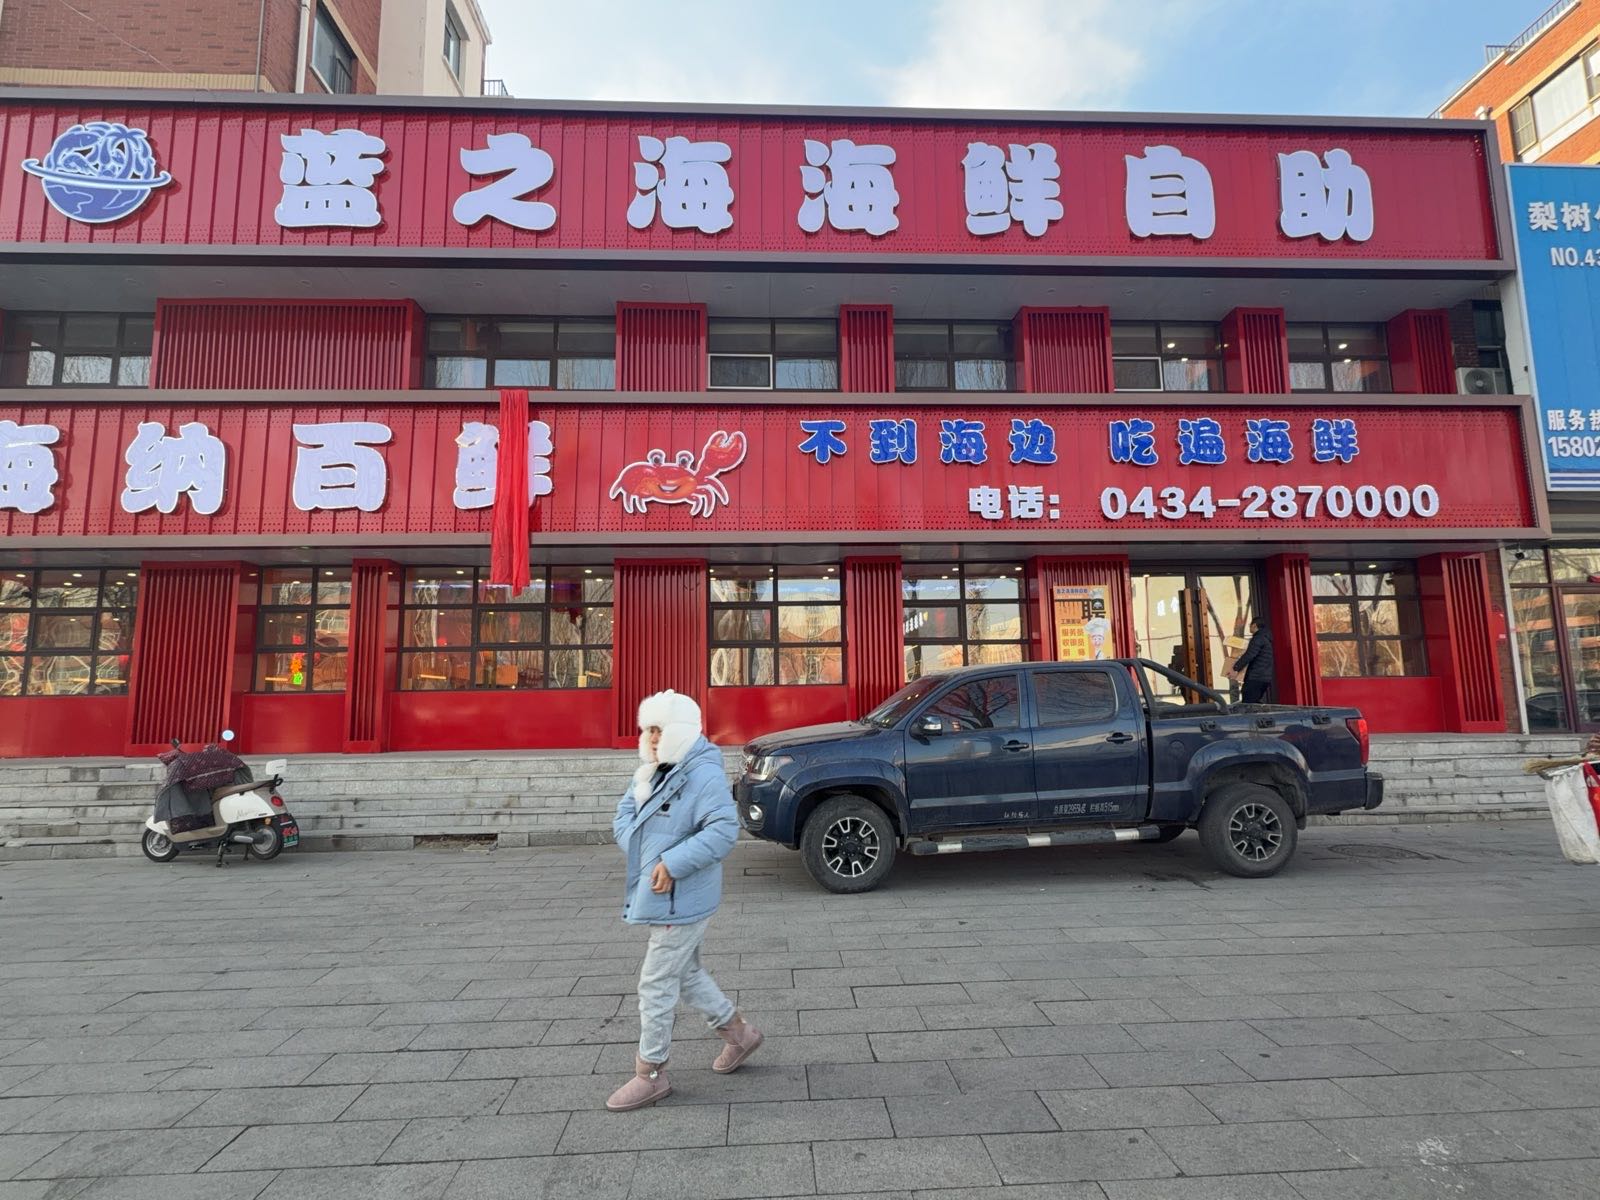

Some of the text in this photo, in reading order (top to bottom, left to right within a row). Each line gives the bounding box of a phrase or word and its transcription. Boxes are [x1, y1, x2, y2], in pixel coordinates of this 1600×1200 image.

[274, 128, 1374, 241] 蓝之海海鲜自助
[1527, 201, 1600, 232] 梨树
[798, 417, 1359, 466] 不到海边 吃遍海鲜
[1101, 484, 1439, 520] 0434-2870000
[1062, 628, 1085, 637] 服务员
